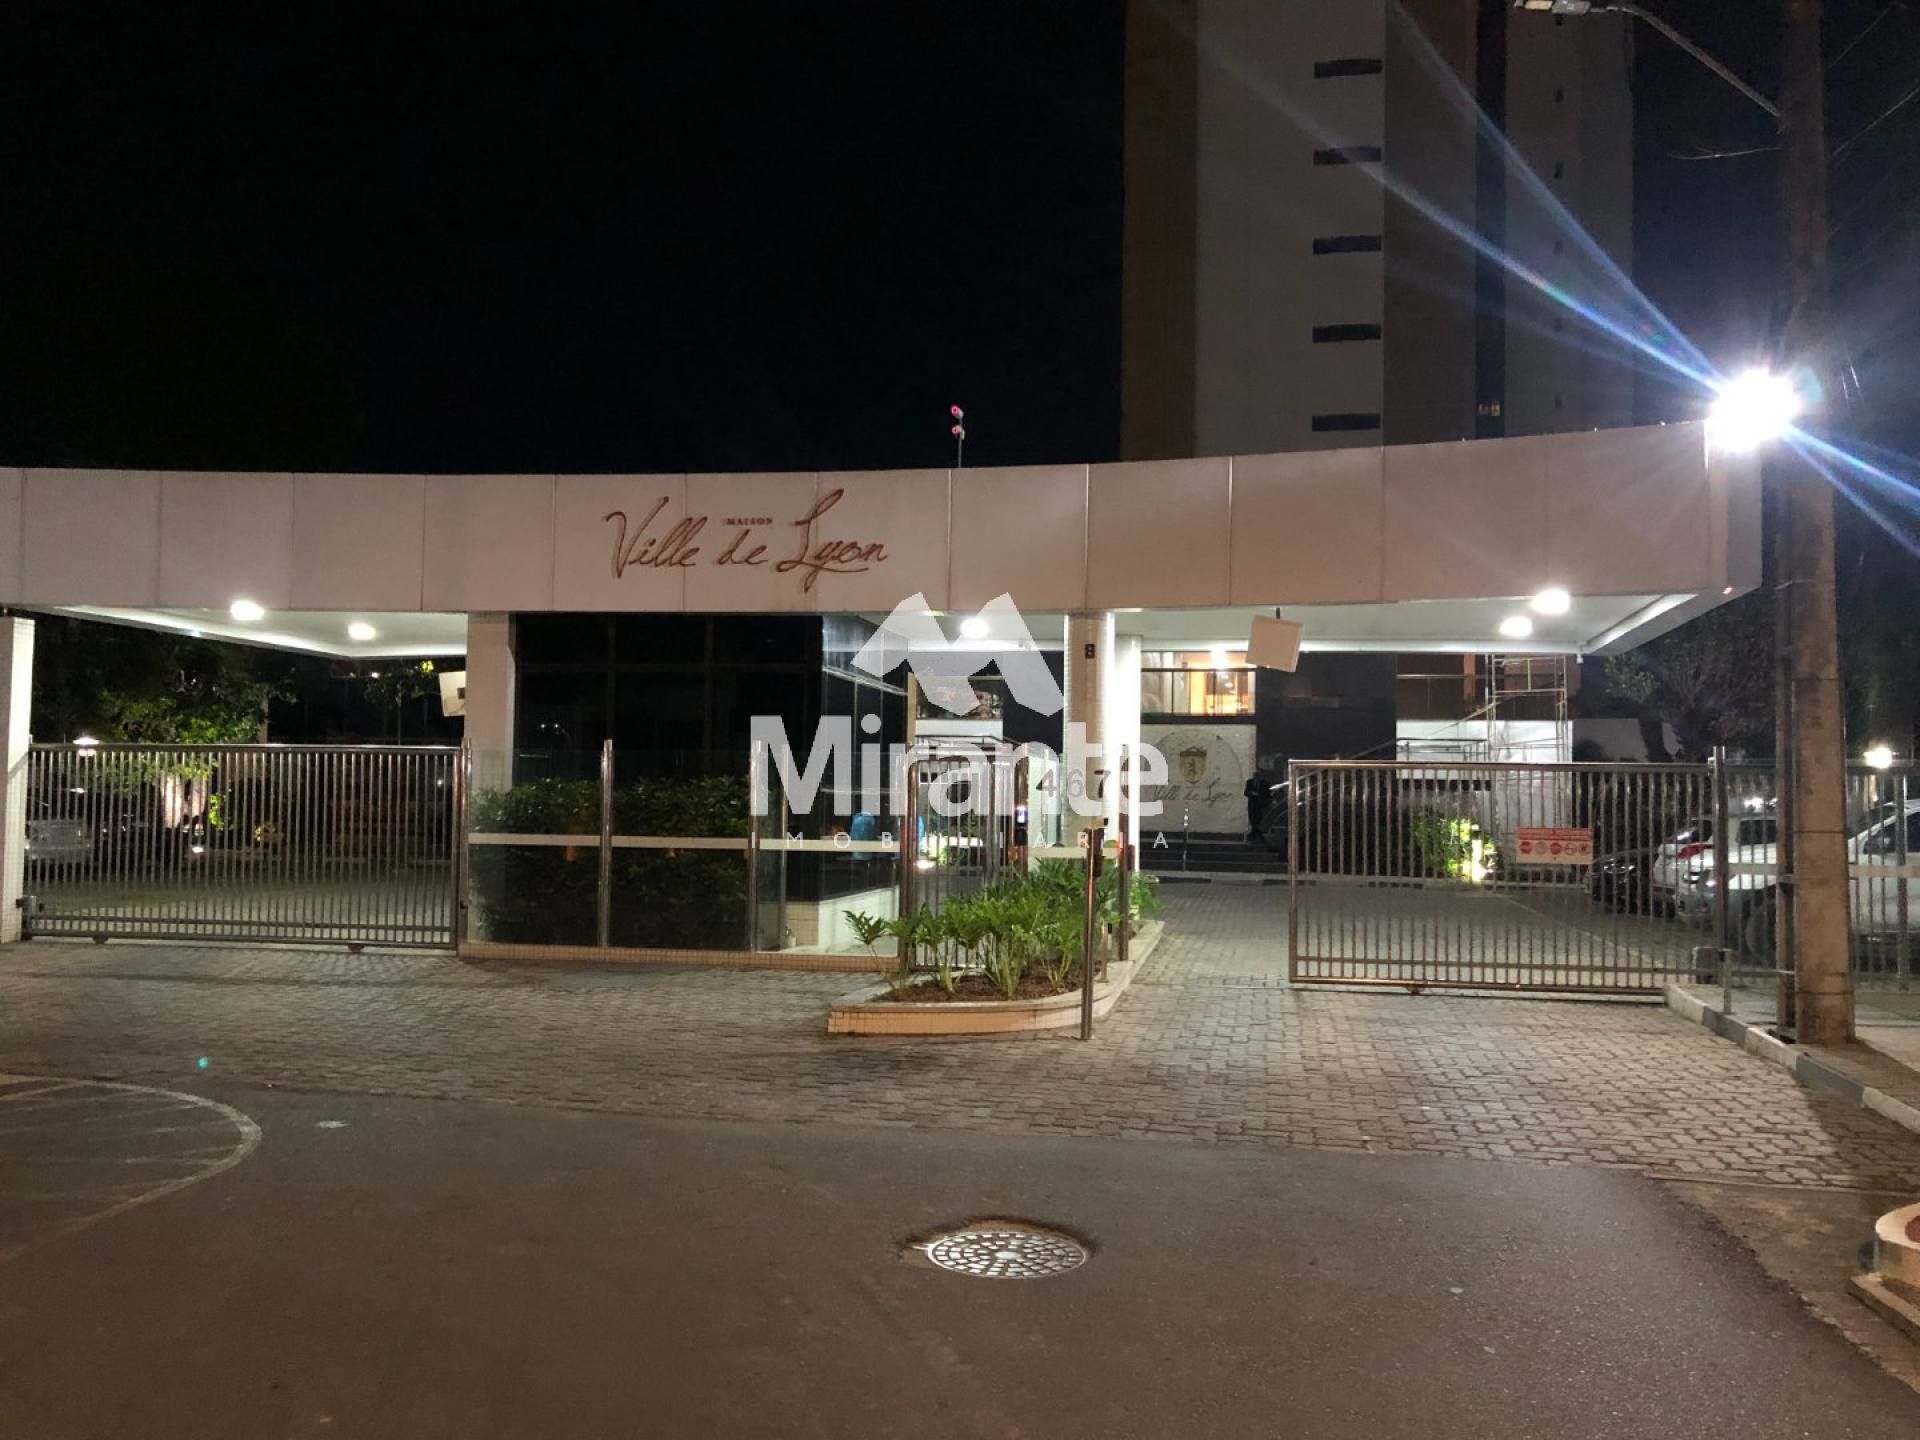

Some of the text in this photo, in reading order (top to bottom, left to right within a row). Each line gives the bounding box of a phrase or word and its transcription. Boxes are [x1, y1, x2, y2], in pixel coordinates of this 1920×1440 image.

[604, 488, 888, 593] Ville de Lyon
[727, 517, 773, 526] MAISON
